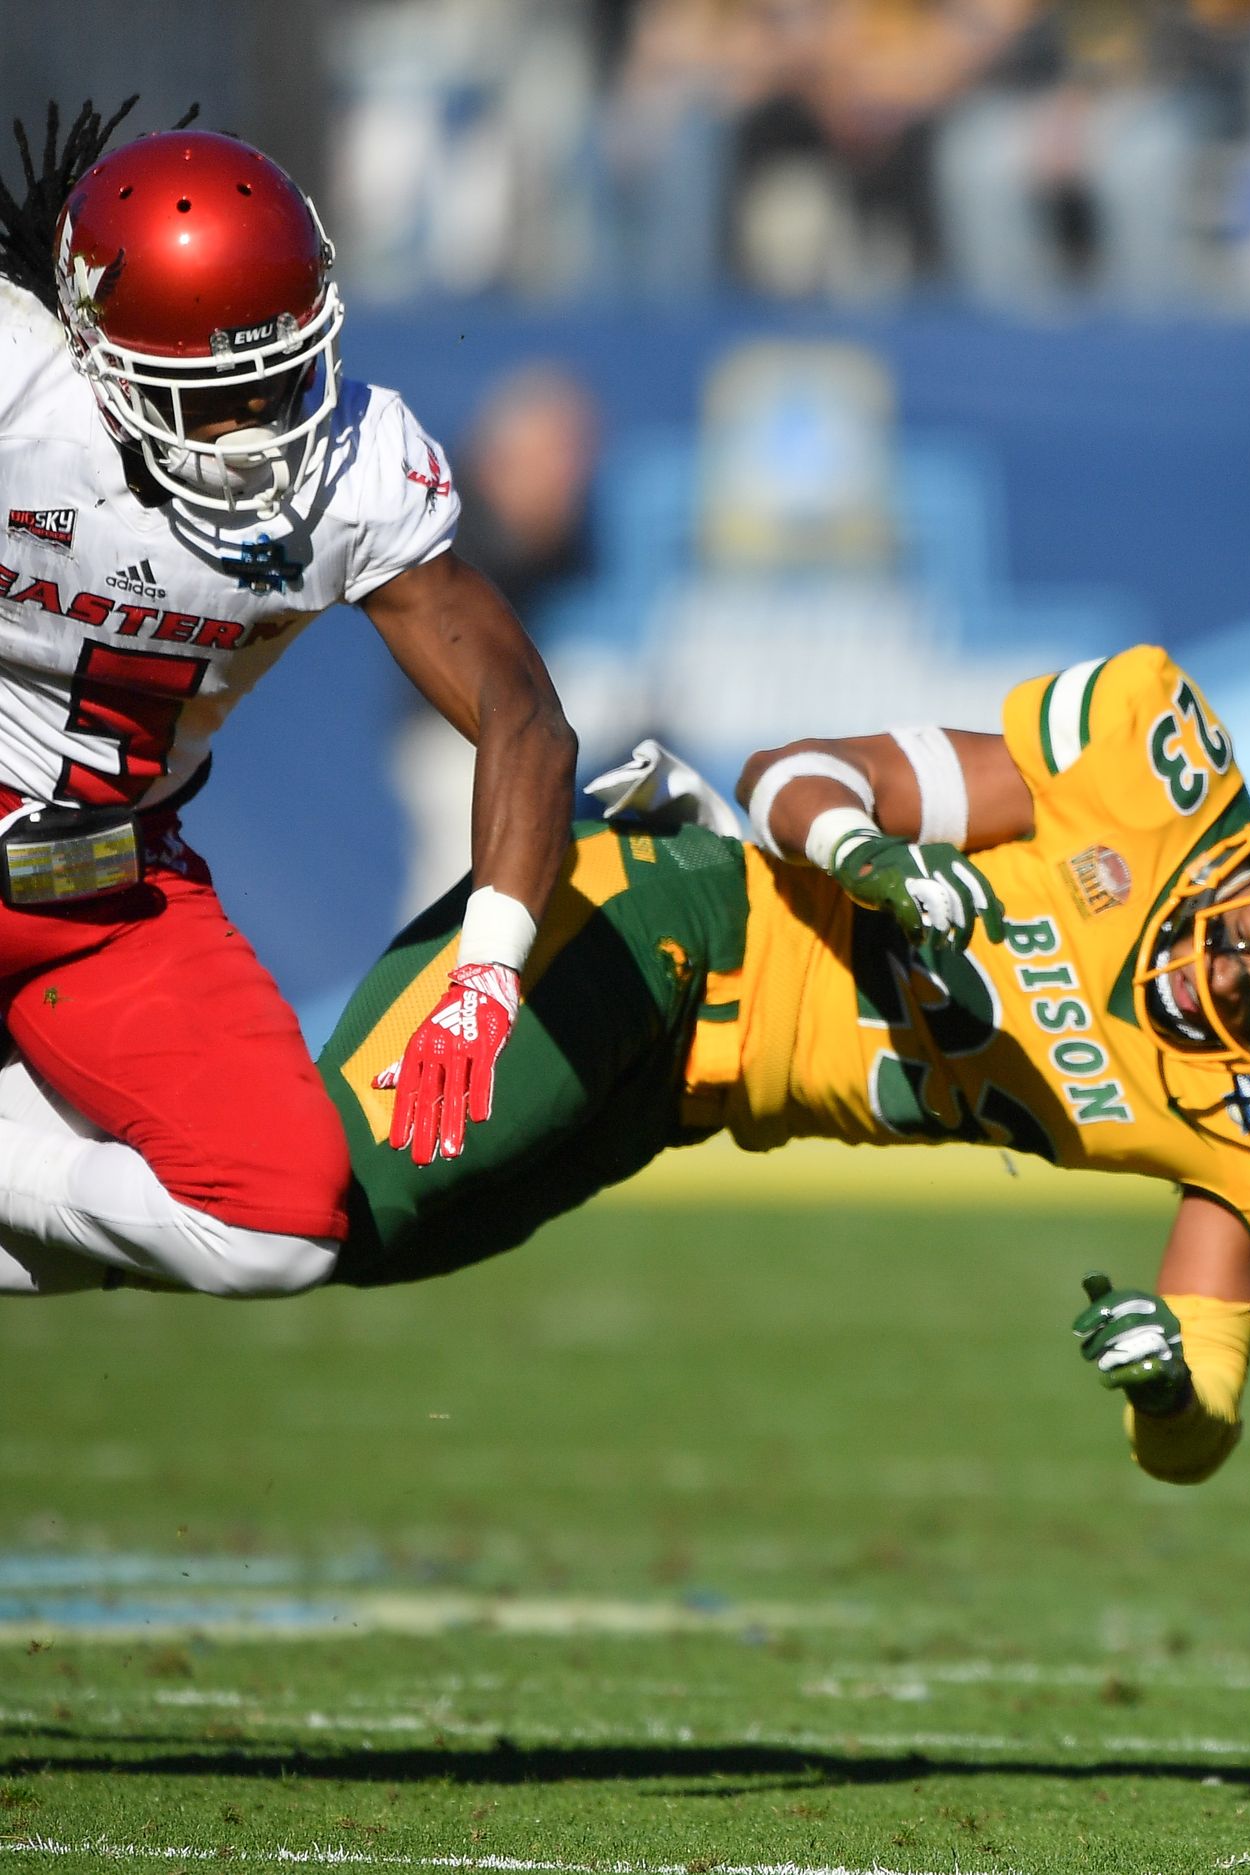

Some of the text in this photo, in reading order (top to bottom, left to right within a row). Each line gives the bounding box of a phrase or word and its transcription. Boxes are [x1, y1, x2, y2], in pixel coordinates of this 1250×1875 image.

[234, 323, 273, 345] EWU
[35, 509, 74, 532] SKY
[105, 574, 166, 600] adidas
[53, 637, 211, 806] 5
[1147, 679, 1233, 816] 23
[462, 990, 478, 1041] adidas
[1003, 915, 1134, 1125] BISON
